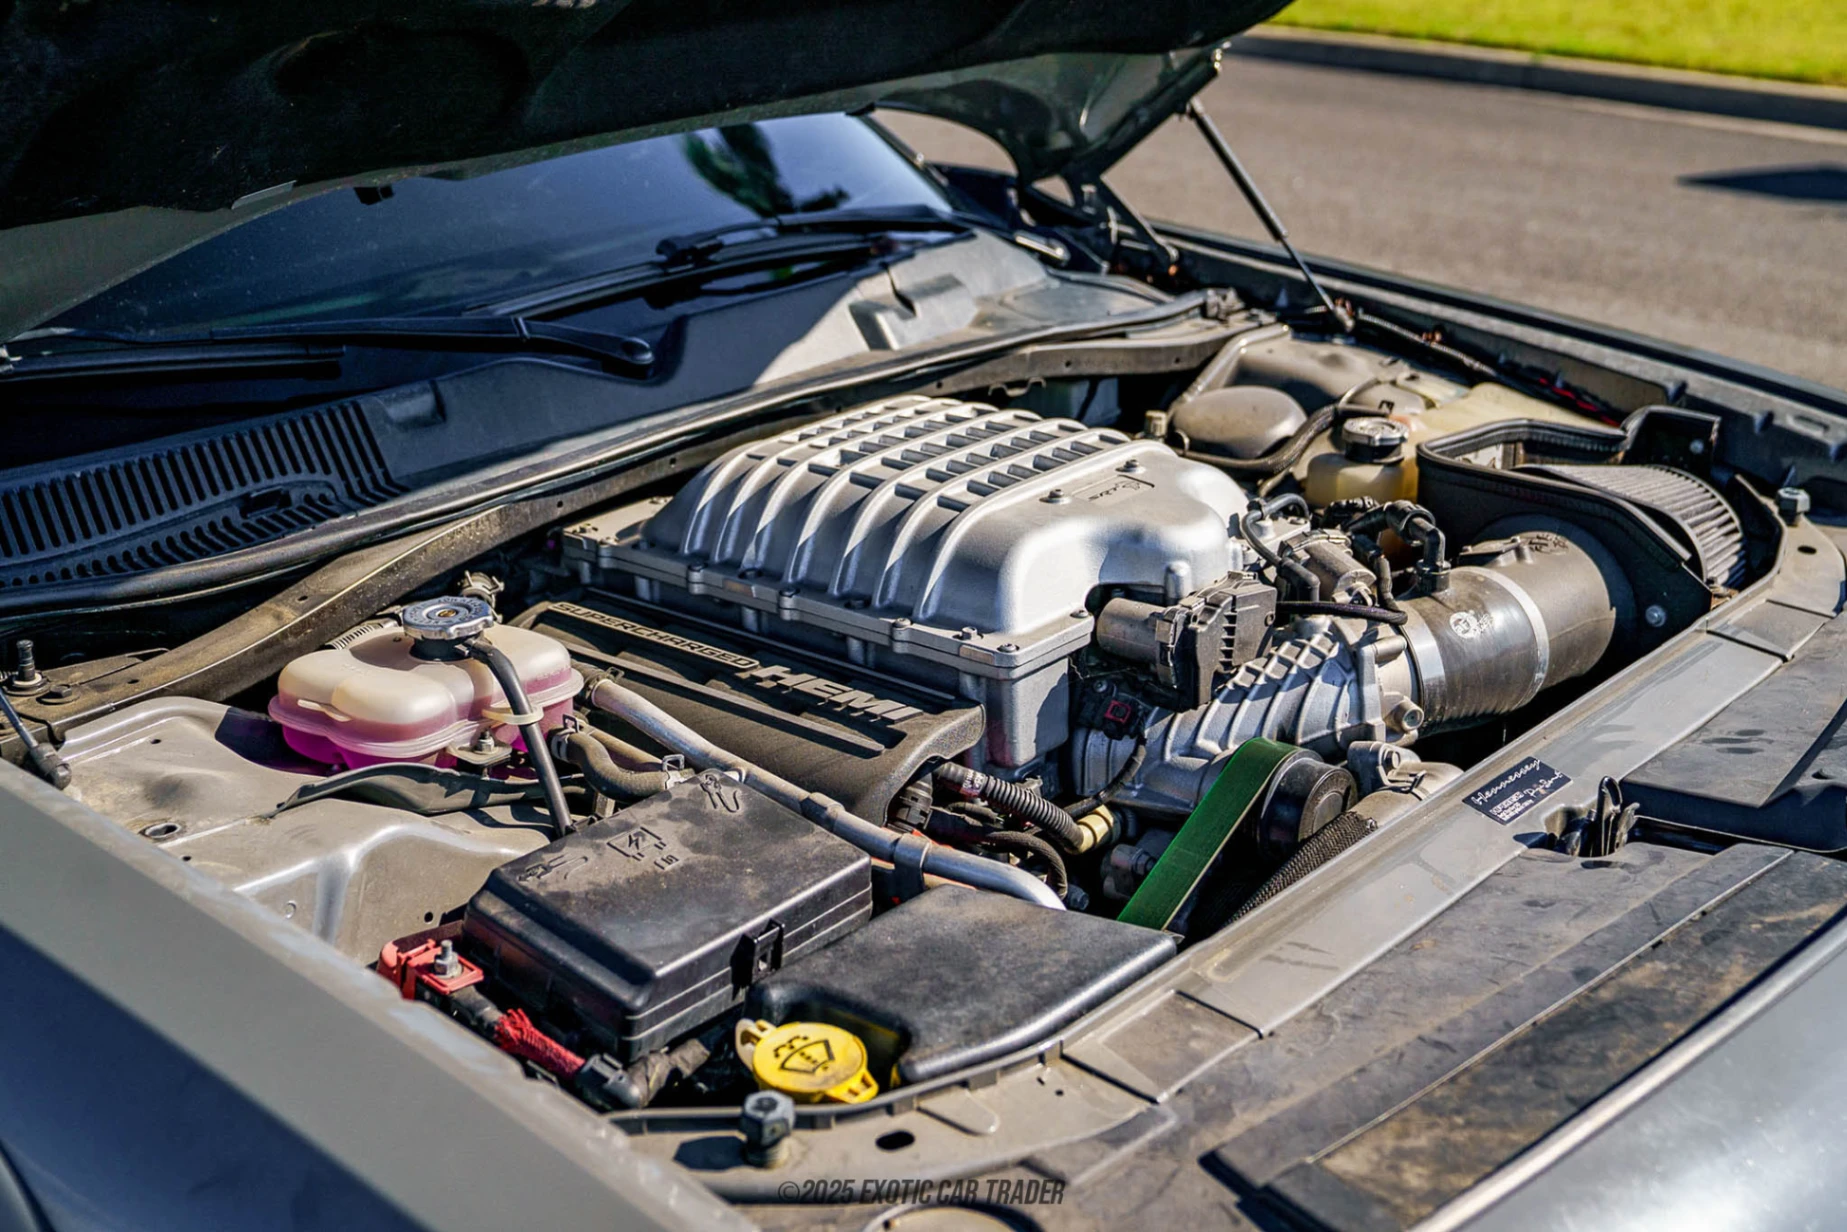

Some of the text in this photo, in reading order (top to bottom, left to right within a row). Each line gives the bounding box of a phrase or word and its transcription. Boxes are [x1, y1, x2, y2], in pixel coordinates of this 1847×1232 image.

[553, 602, 756, 667] SUPERCHARGED
[750, 665, 923, 723] HEMI
[1470, 759, 1541, 806] Hennessey
